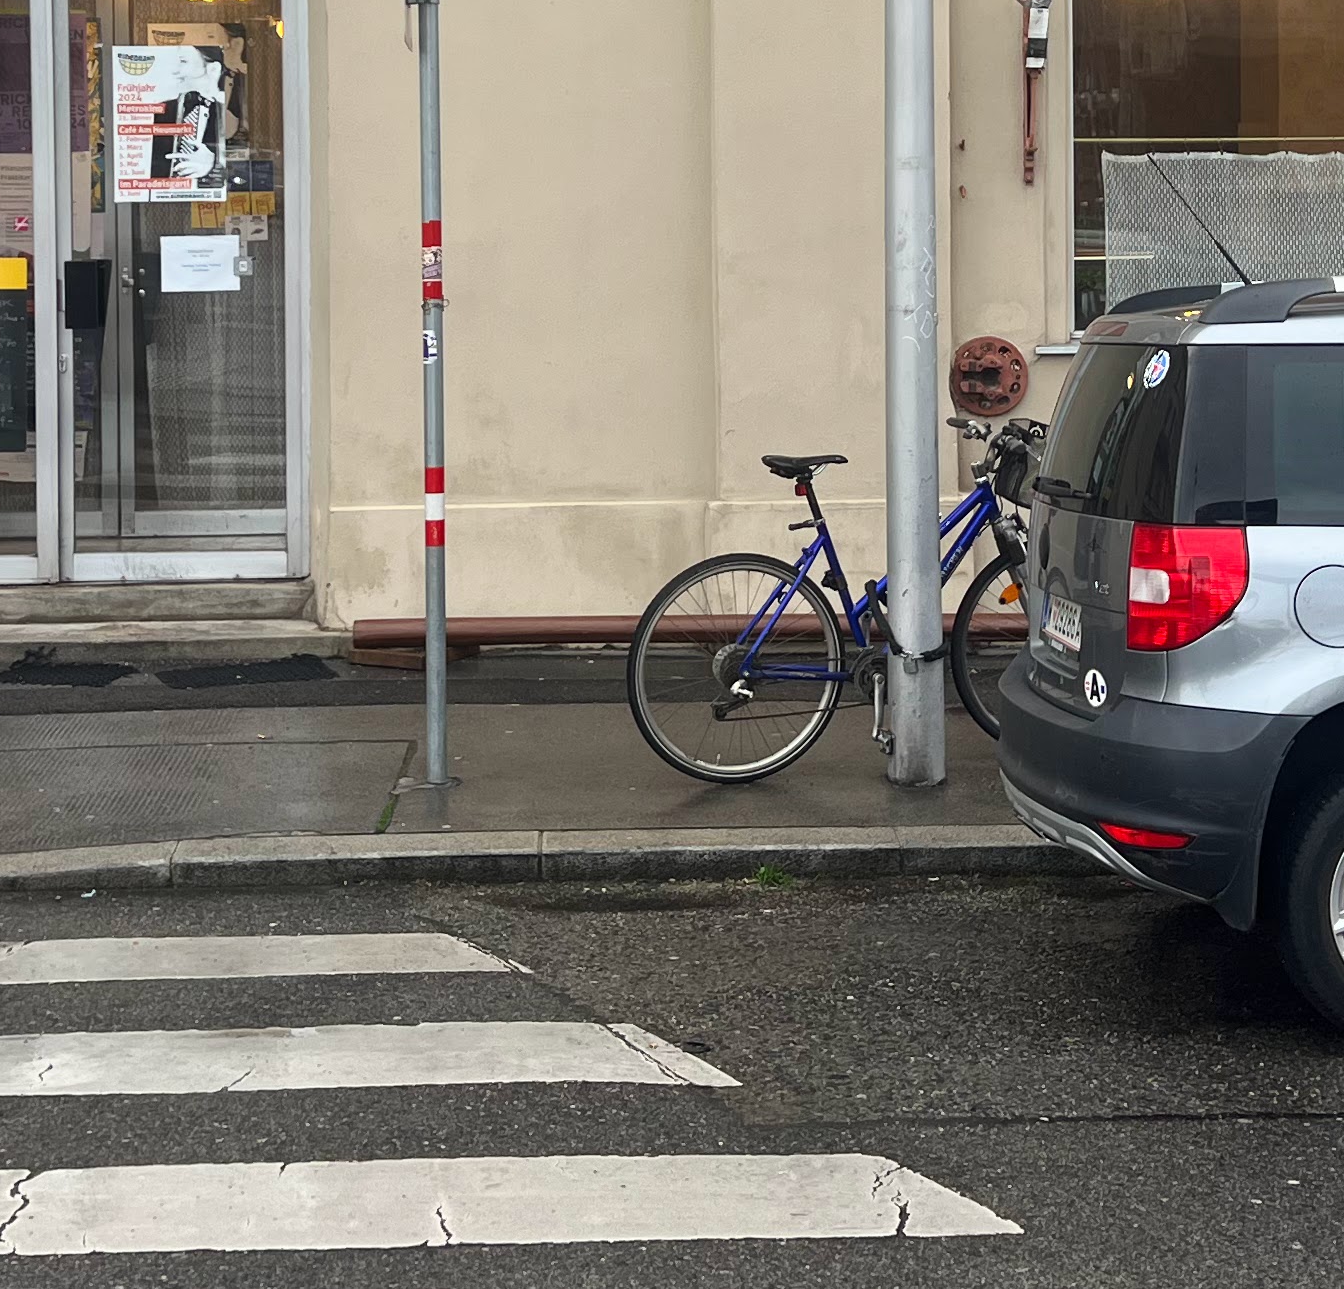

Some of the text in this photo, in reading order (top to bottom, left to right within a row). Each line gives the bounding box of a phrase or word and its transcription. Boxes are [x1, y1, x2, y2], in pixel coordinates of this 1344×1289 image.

[117, 83, 156, 95] Frühjahr
[118, 94, 143, 102] 2024
[119, 125, 192, 134] Café Am Heumarkt
[1090, 673, 1101, 702] A
